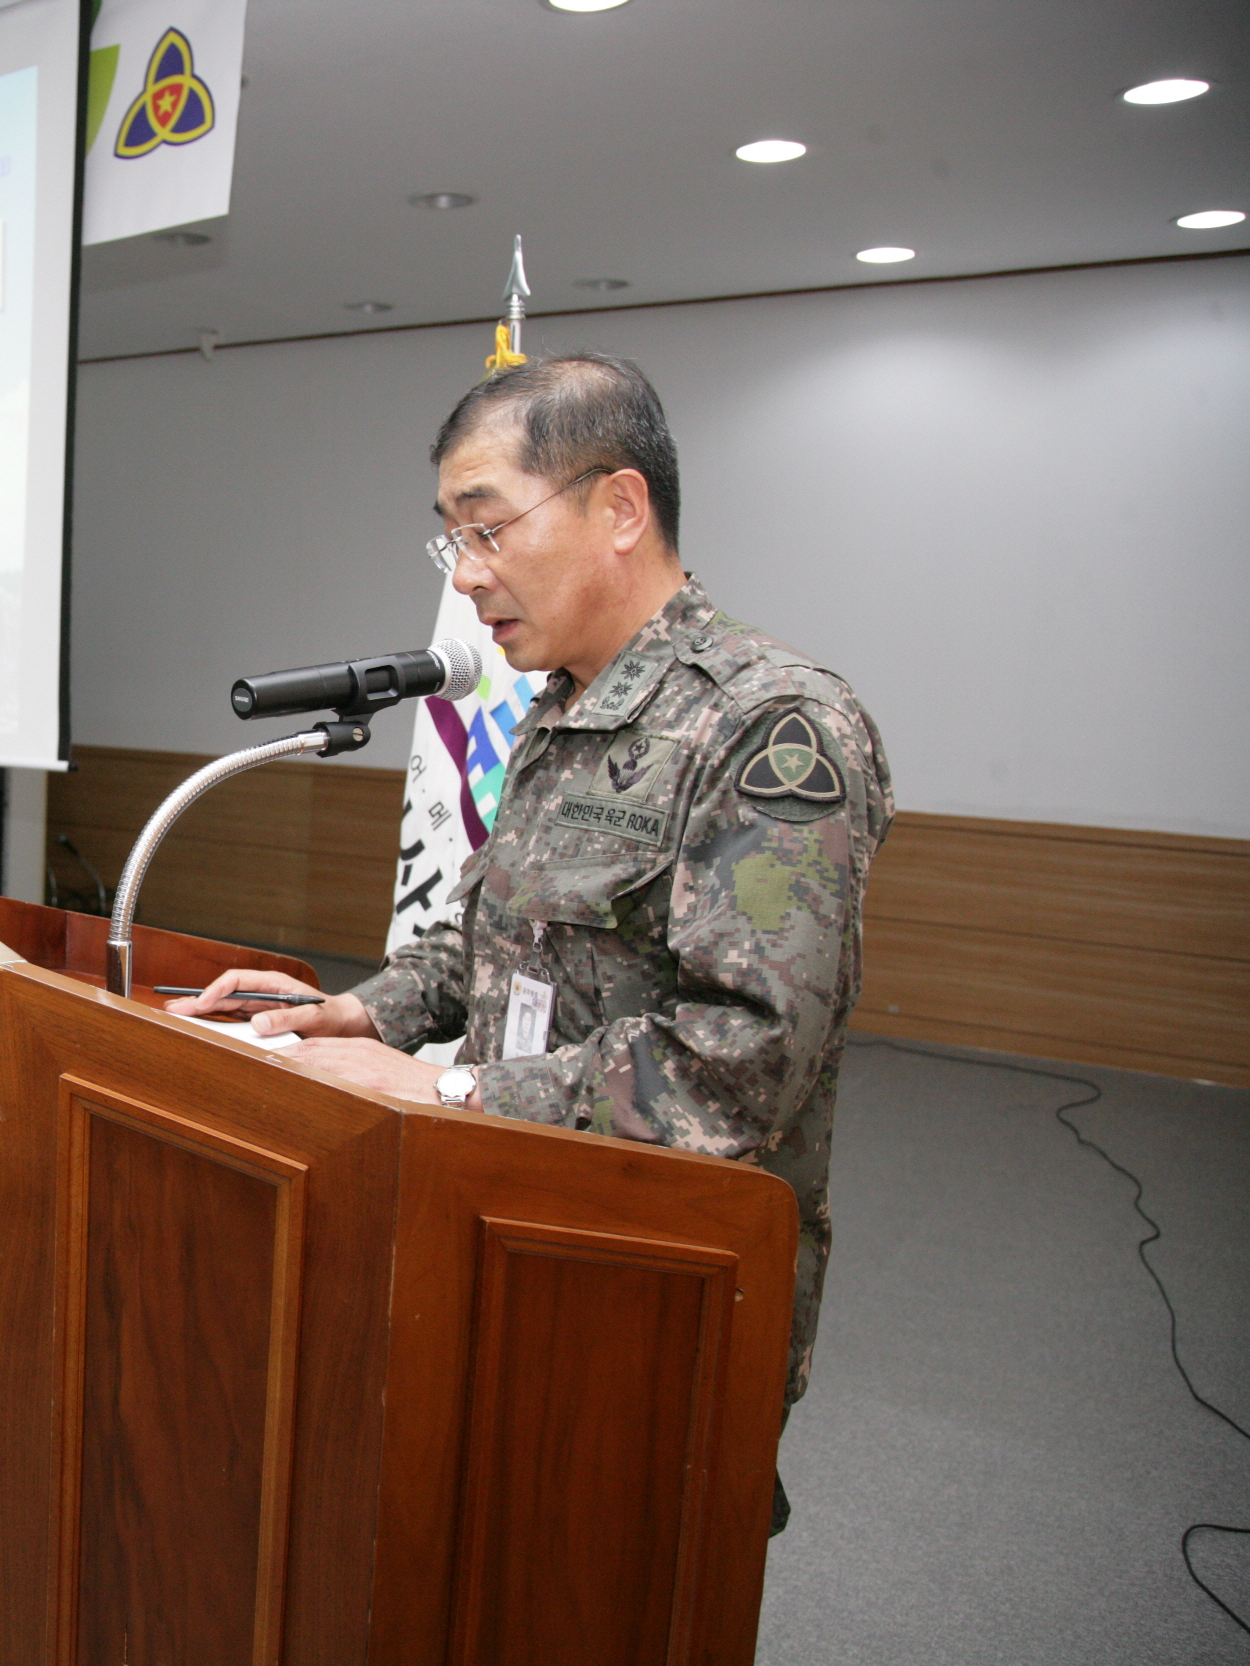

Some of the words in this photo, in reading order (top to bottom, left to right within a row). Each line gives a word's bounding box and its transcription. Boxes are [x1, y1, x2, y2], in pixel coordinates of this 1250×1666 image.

[561, 801, 604, 824] 대한민국
[604, 808, 627, 827] 육군
[626, 813, 659, 837] ROKA
